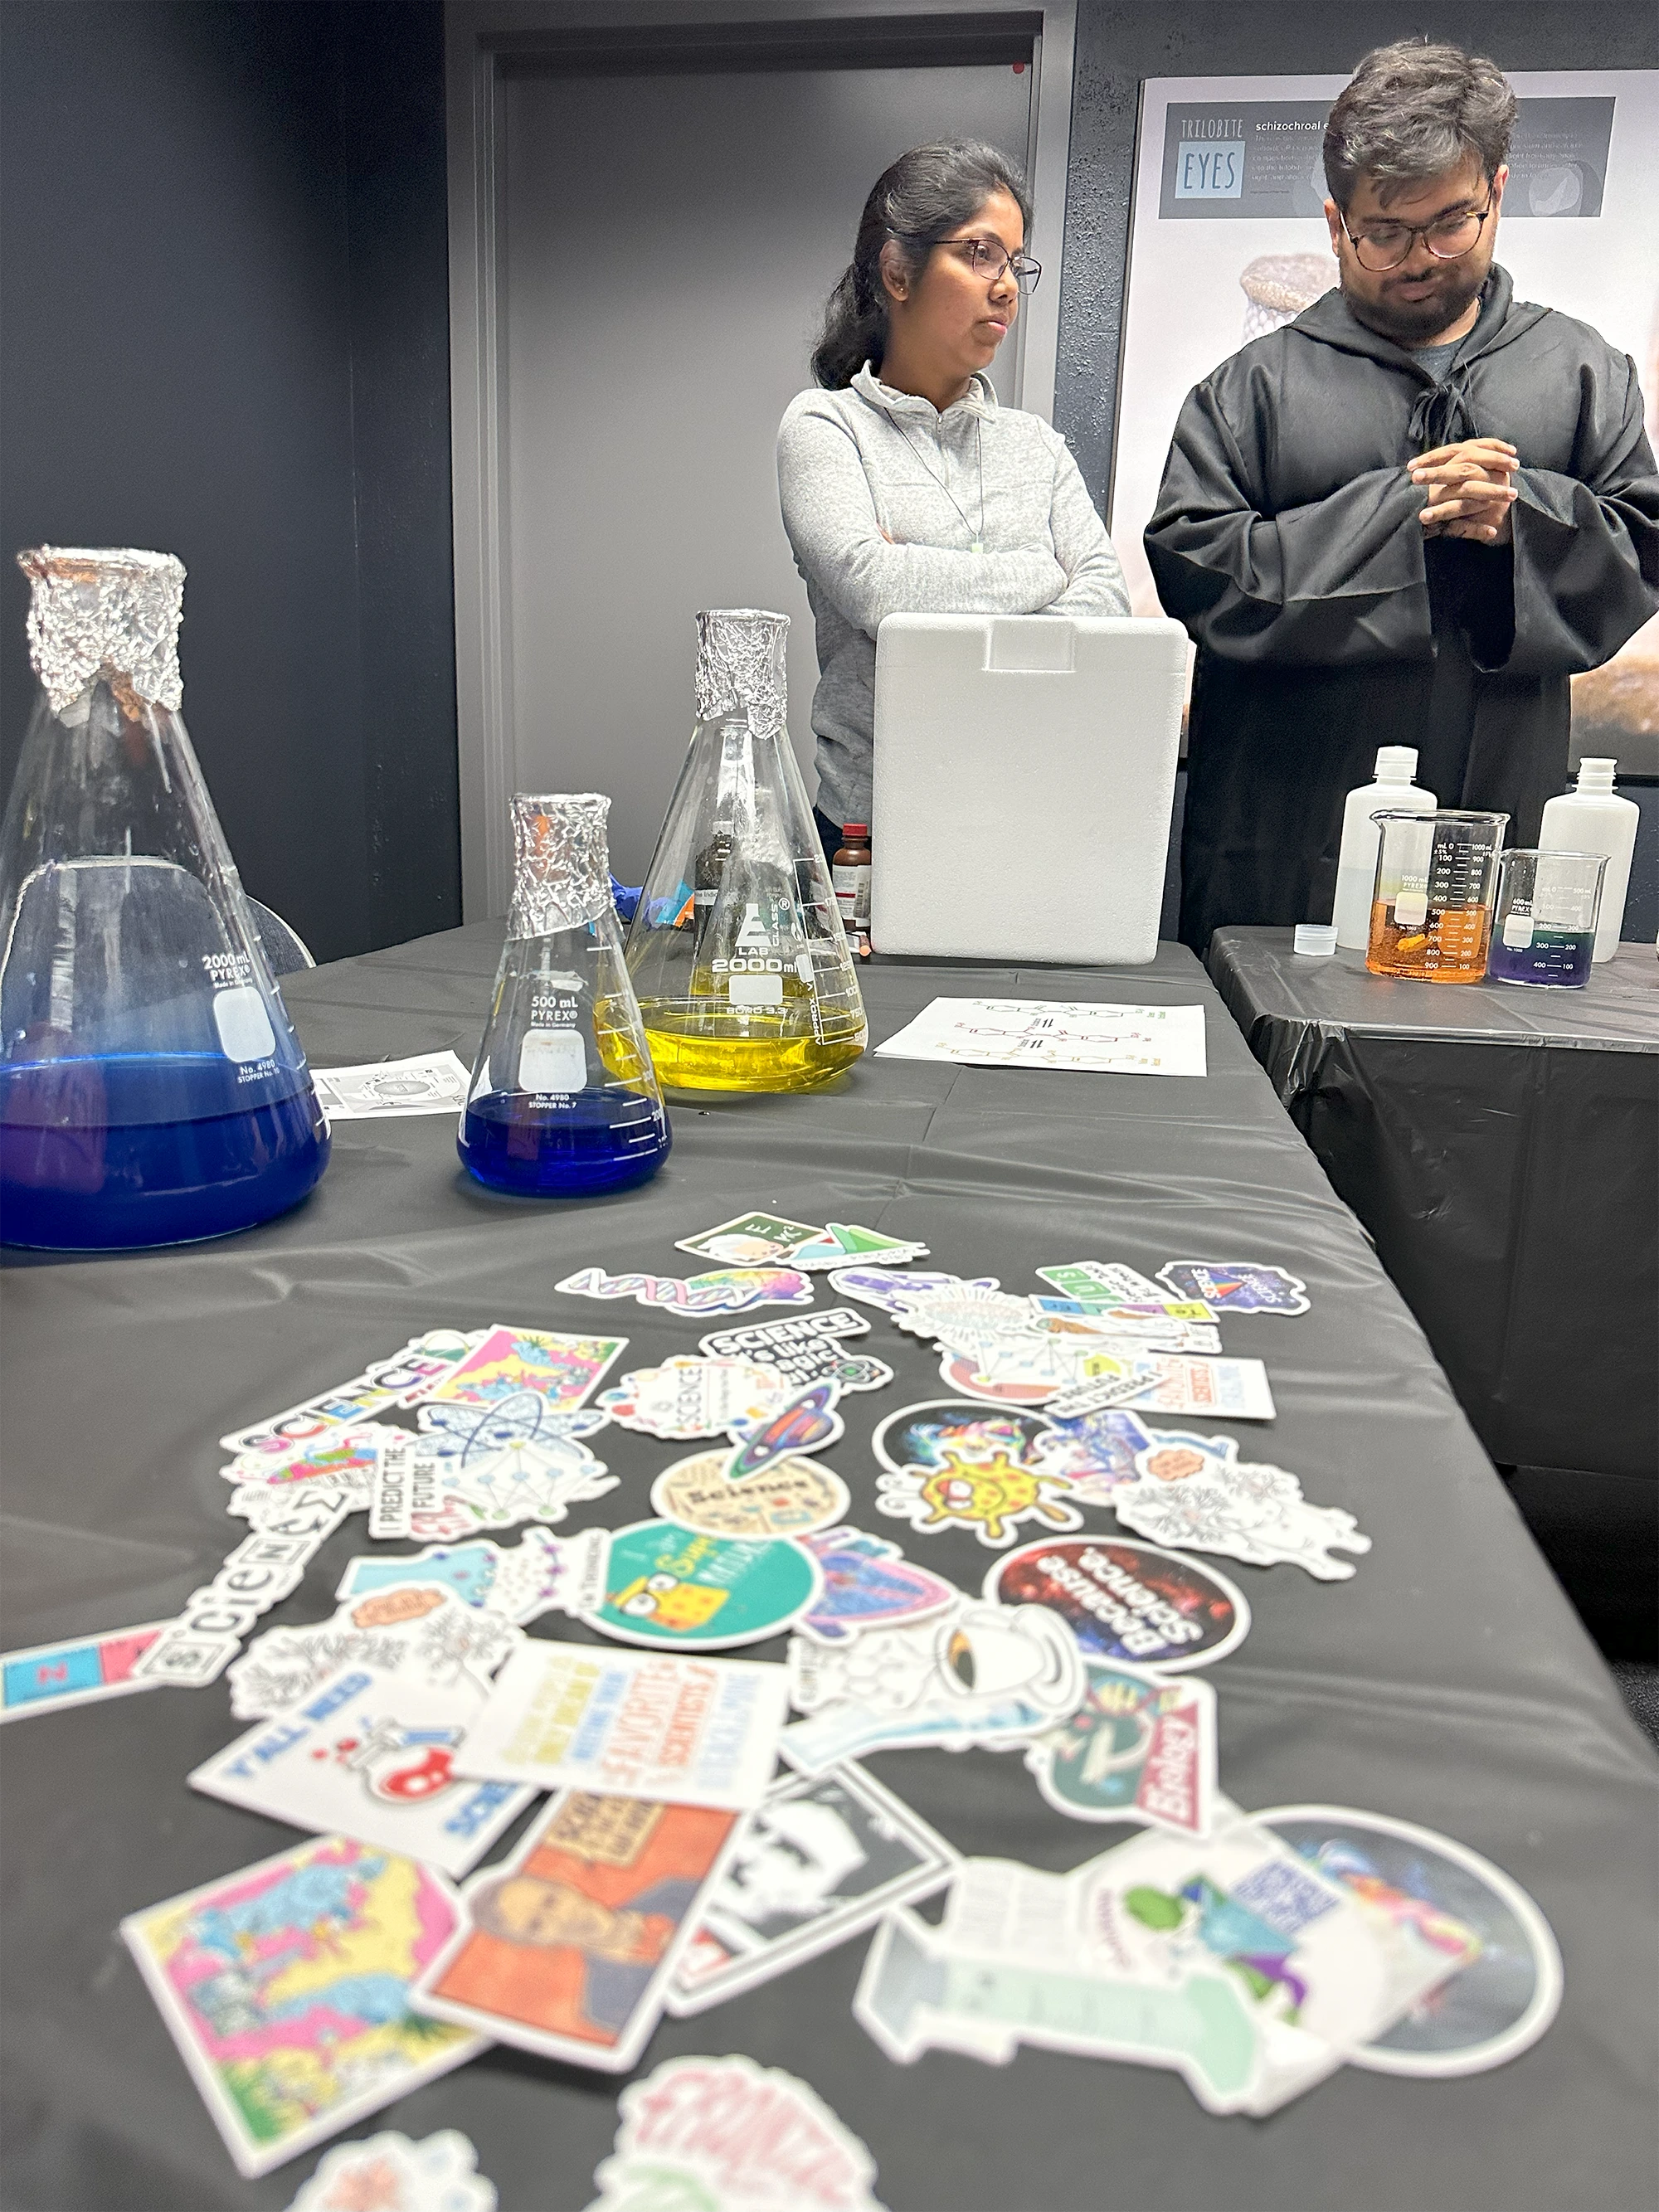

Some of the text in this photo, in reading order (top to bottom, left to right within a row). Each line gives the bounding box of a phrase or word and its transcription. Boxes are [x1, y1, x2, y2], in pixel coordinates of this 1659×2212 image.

[1181, 119, 1244, 139] TRILOBITE
[1255, 121, 1321, 131] schizochroal
[1183, 151, 1236, 190] EYES
[771, 903, 780, 946] GLASS
[202, 951, 251, 970] 2000 mL
[738, 947, 769, 955] LAB
[531, 996, 578, 1009] 500 mL
[237, 1072, 264, 1083] STOPPER
[239, 1059, 275, 1076] No. 4980
[528, 1101, 557, 1110] STOPPER
[535, 1093, 570, 1101] No. 4980
[712, 1310, 859, 1354] SCIENCE
[773, 1350, 838, 1374] agic
[241, 1359, 450, 1456] SCIENCE
[677, 1367, 703, 1425] SCIENCE
[384, 1447, 406, 1469] THE
[379, 1471, 406, 1523] PREDICT
[412, 1462, 436, 1510] FUTURE
[687, 1477, 809, 1505] Science
[1037, 1555, 1163, 1655] Because
